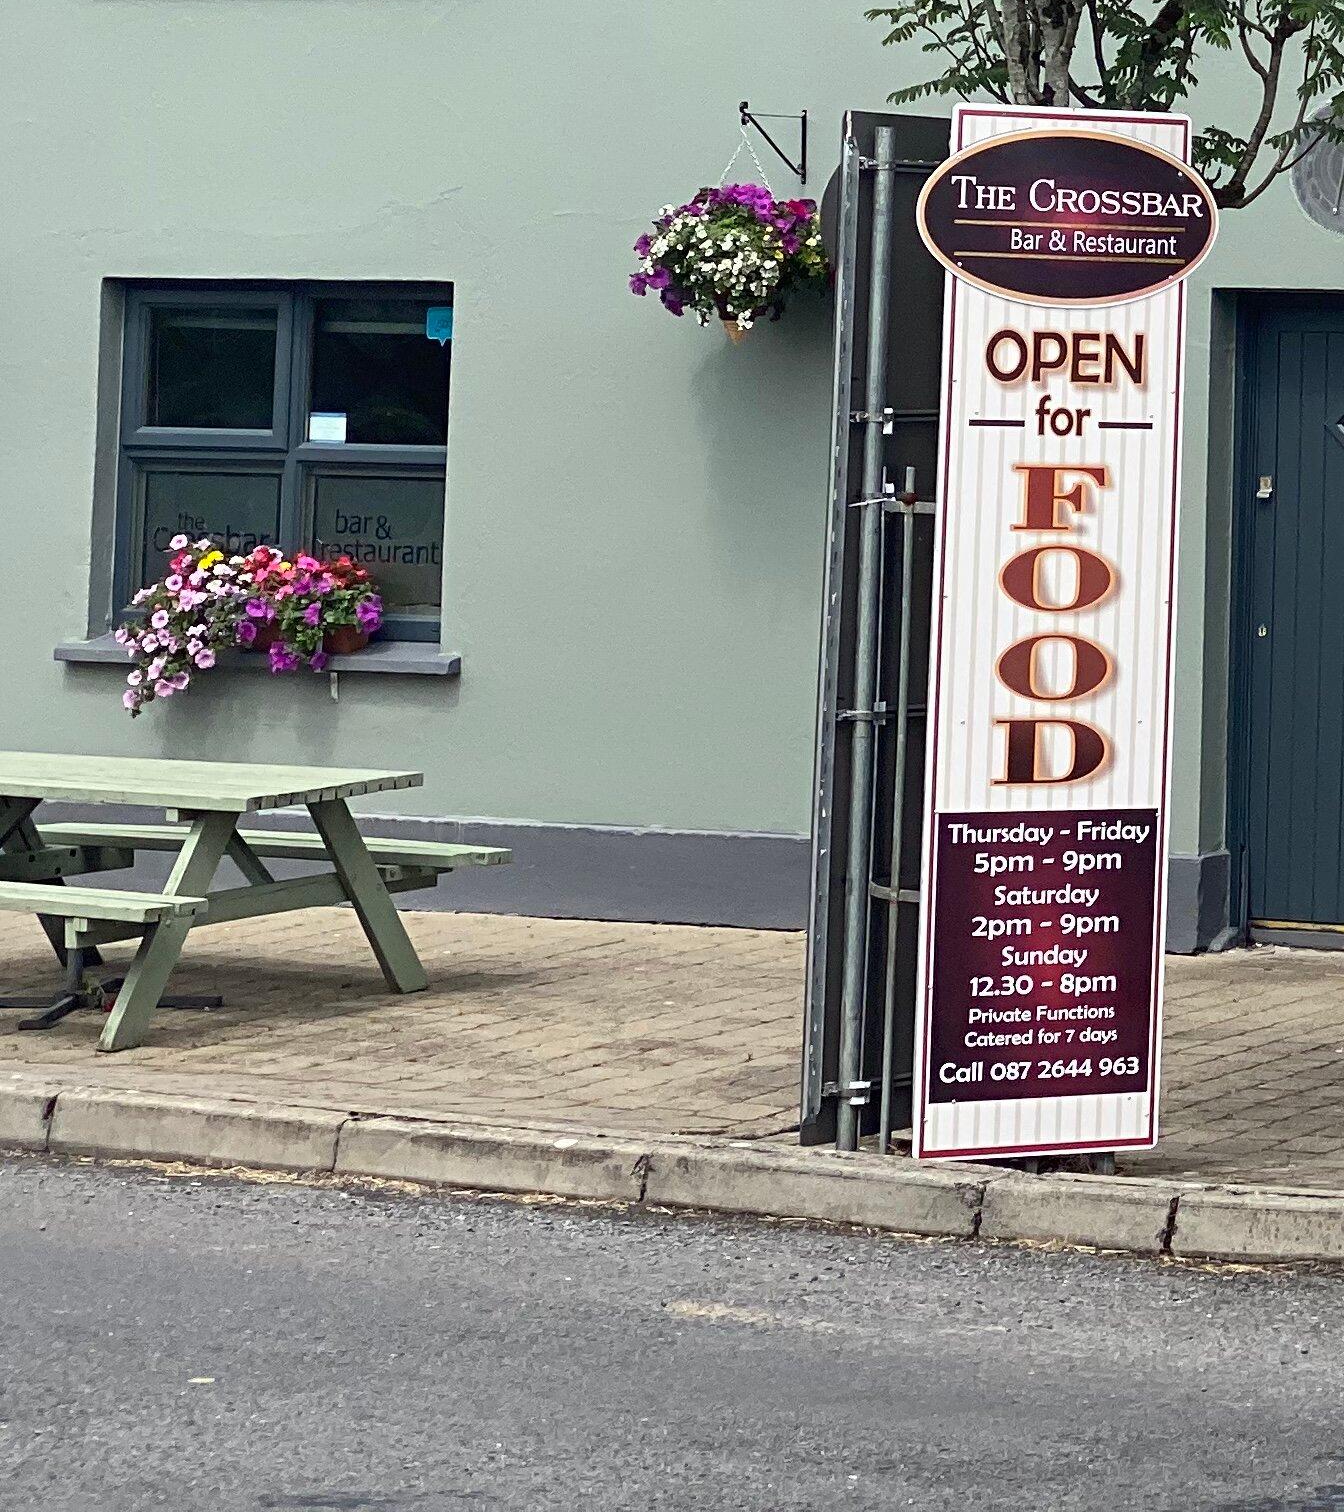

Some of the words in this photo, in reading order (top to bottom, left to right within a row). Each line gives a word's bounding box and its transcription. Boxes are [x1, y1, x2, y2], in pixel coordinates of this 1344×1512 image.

[950, 175, 1017, 211] THE
[1029, 178, 1204, 218] CROSSBAR
[1010, 228, 1044, 251] Bar
[1048, 229, 1067, 252] &
[1073, 230, 1177, 256] Restaurant
[984, 329, 1146, 386] OPEN
[1034, 394, 1092, 437] for
[335, 508, 372, 535] bar
[375, 514, 392, 540] &
[320, 539, 442, 566] restaurant
[990, 465, 1116, 787] FOOD
[947, 822, 1054, 846] Thursday
[1059, 828, 1071, 836] -
[1076, 819, 1150, 844] Friday
[973, 852, 1034, 877] 5pm
[1042, 857, 1055, 865] -
[1062, 850, 1122, 875] 9pm
[994, 883, 1100, 907] Saturday
[971, 915, 1032, 941] 2pm
[1039, 920, 1053, 928] -
[1059, 913, 1120, 938] 9pm
[1001, 944, 1088, 968] Sunday
[969, 974, 1034, 997] 12.30
[1040, 980, 1054, 988] -
[1059, 973, 1117, 997] 8pm
[968, 1007, 1032, 1024] Private
[1036, 1004, 1115, 1022] Functions
[964, 1029, 1034, 1048] Catered
[1037, 1028, 1062, 1045] for
[1065, 1029, 1076, 1043] 7
[1079, 1027, 1118, 1045] days
[938, 1061, 984, 1084] Call
[989, 1061, 1032, 1081] 087
[1037, 1058, 1093, 1079] 2644
[1098, 1056, 1140, 1076] 963
